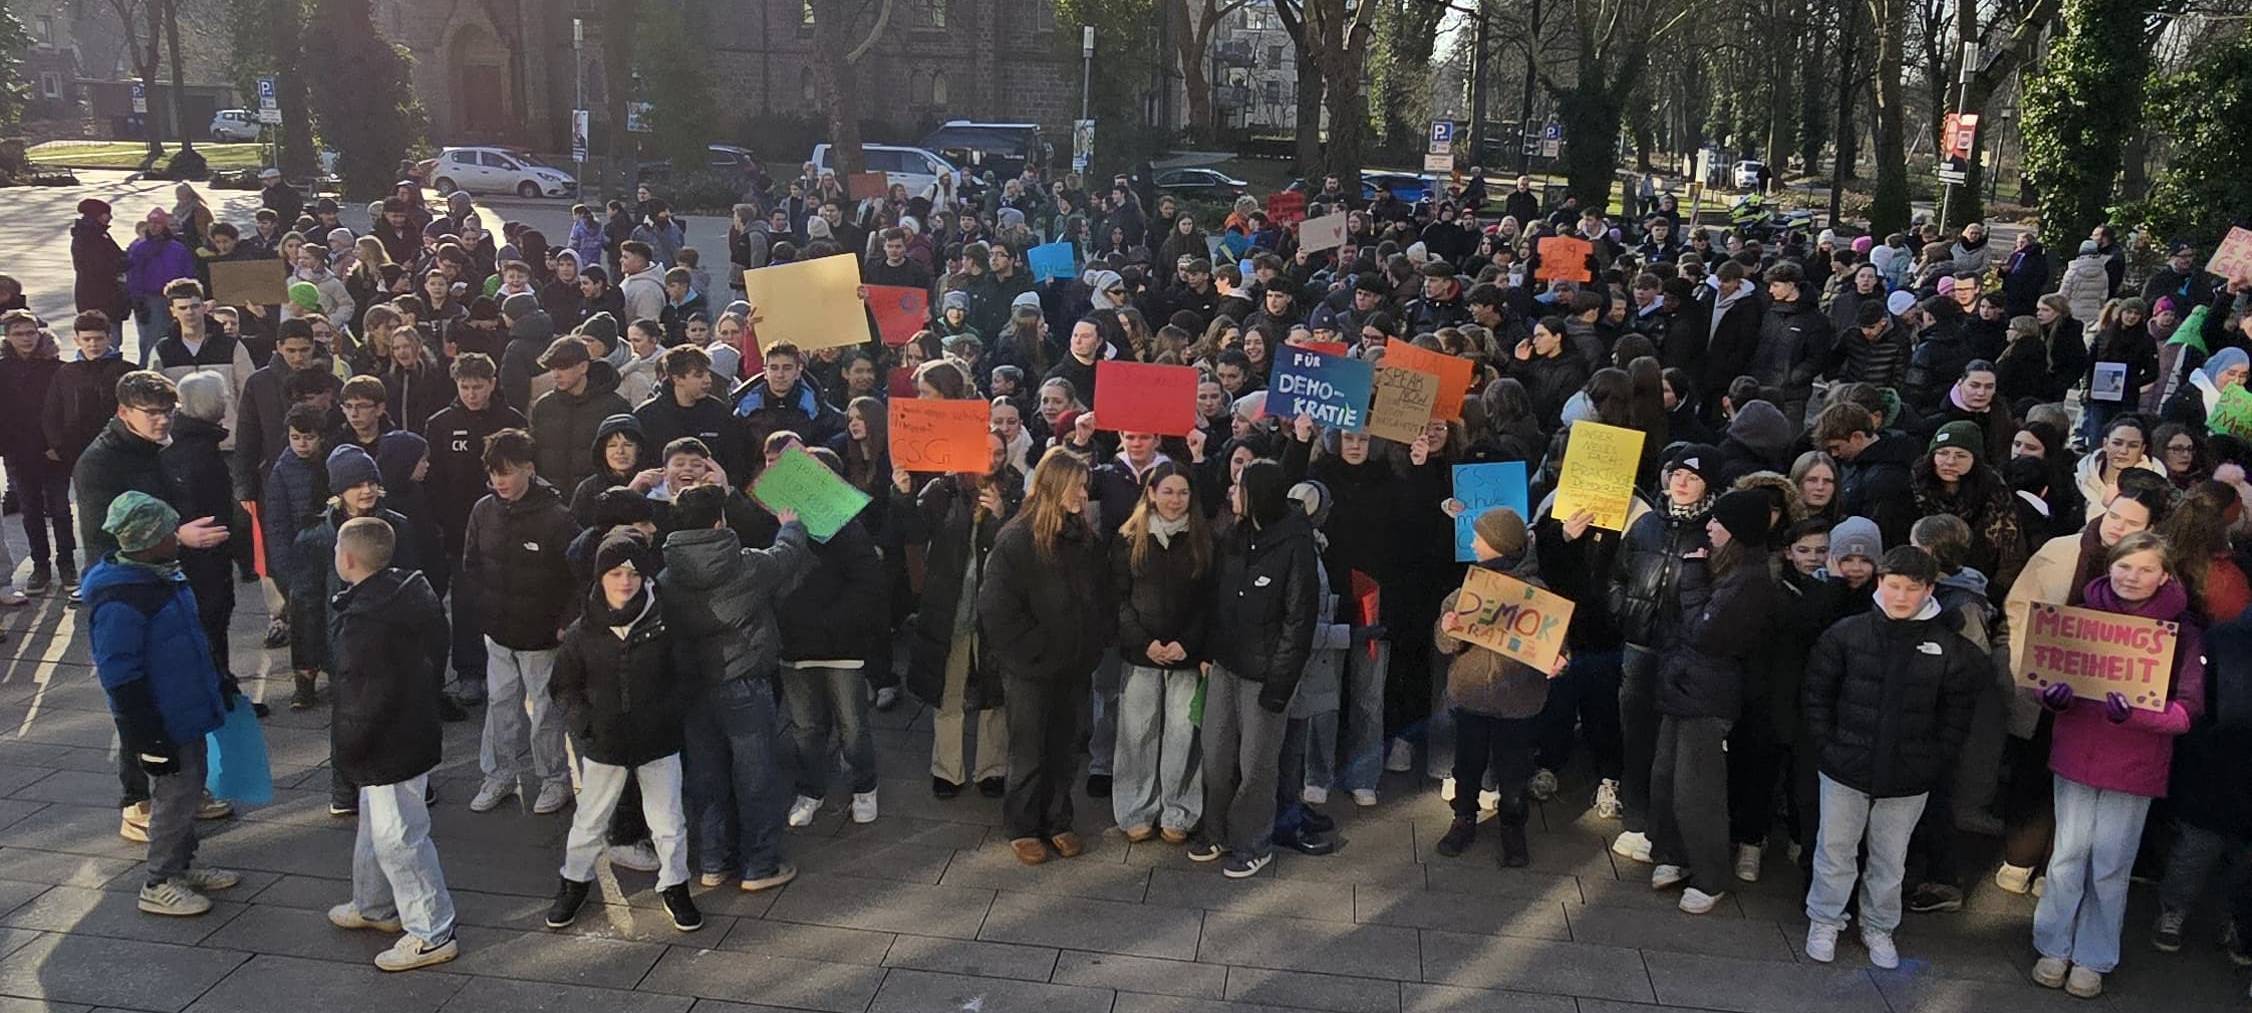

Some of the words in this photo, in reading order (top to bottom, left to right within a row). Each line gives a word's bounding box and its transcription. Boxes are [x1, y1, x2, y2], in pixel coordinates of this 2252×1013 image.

[1434, 125, 1446, 140] P
[1546, 126, 1556, 138] P
[1294, 353, 1321, 368] FÜR
[1293, 397, 1358, 426] KRATIE
[452, 440, 468, 451] CK
[2034, 609, 2168, 654] MEINUNGS
[2034, 645, 2160, 683] FREIHEIT
